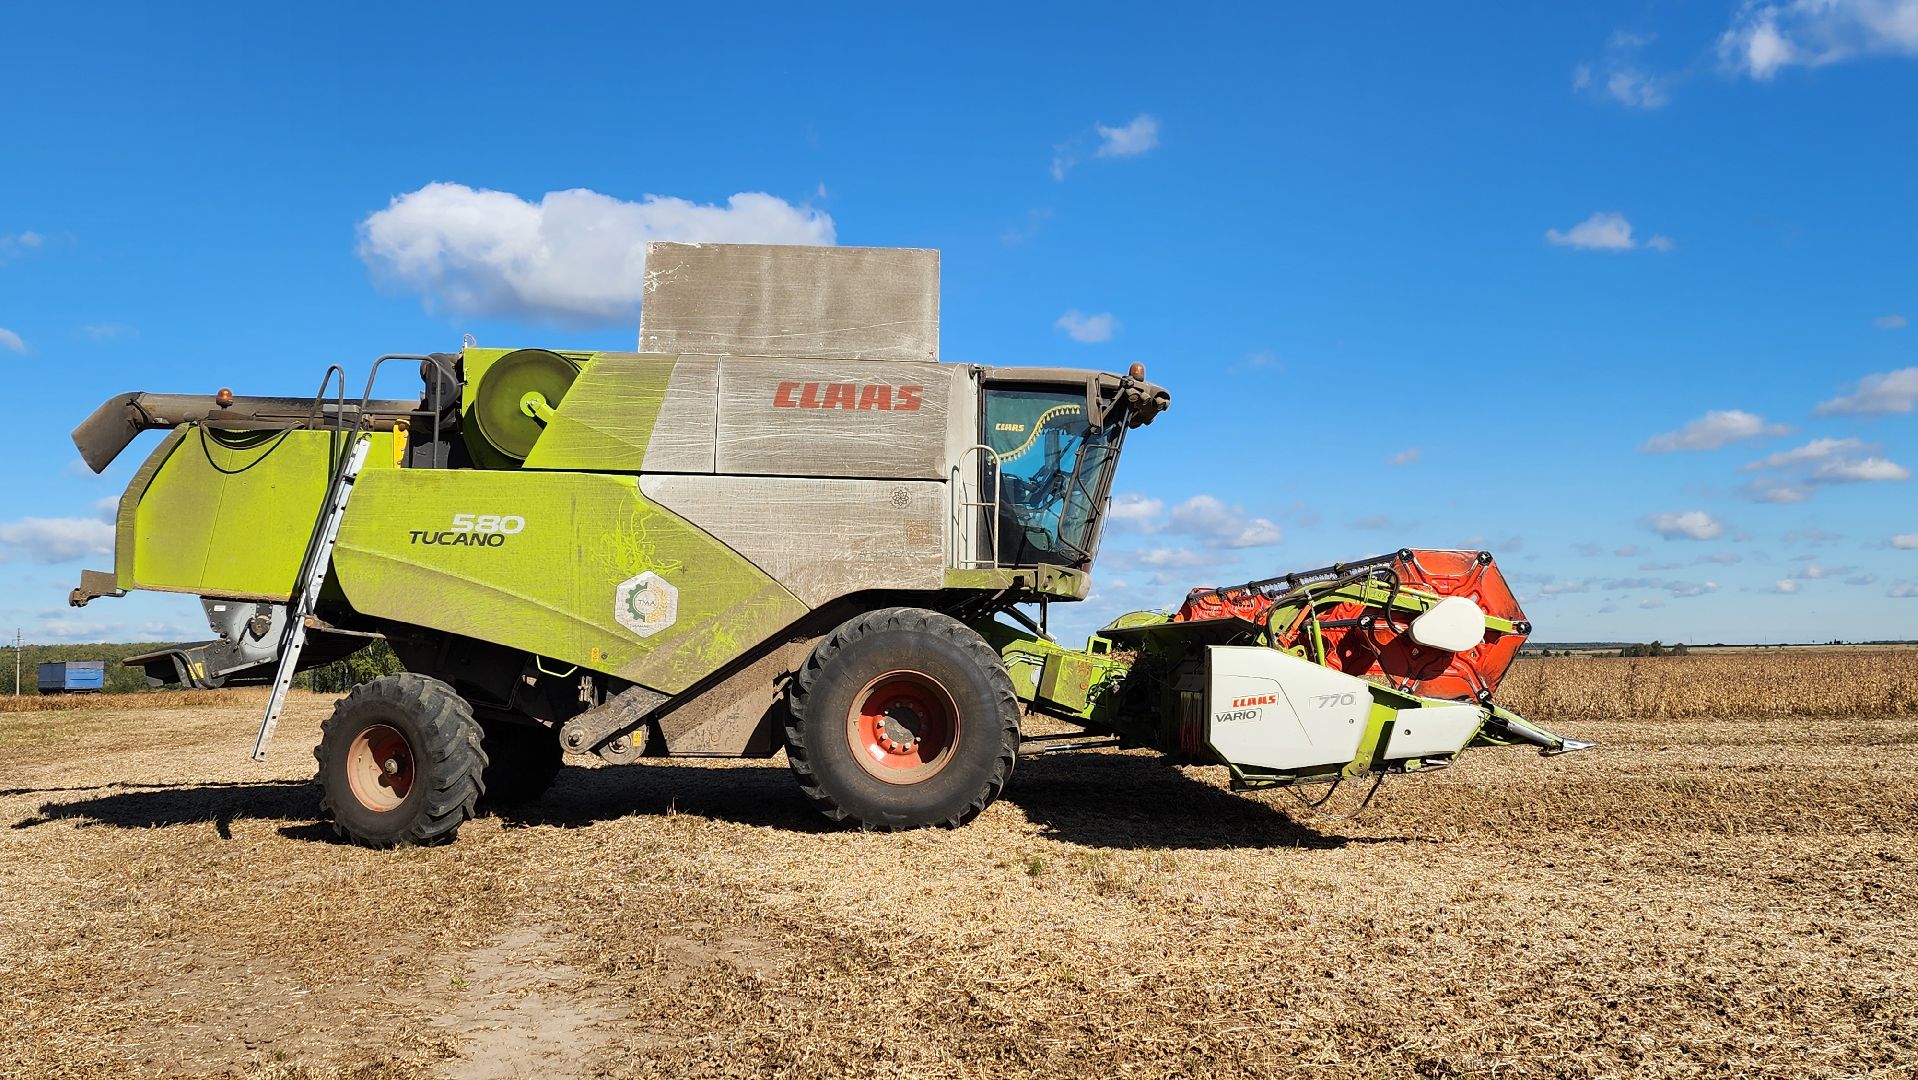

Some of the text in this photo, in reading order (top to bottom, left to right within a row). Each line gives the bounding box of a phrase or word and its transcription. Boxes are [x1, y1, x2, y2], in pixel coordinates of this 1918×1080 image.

[773, 382, 924, 411] CLAAS
[995, 423, 1025, 432] CLAAS
[450, 513, 526, 534] 580
[409, 531, 505, 547] TUCANO
[1232, 694, 1277, 708] CLAAS
[1319, 693, 1355, 709] 770
[1216, 710, 1257, 723] VARIO
